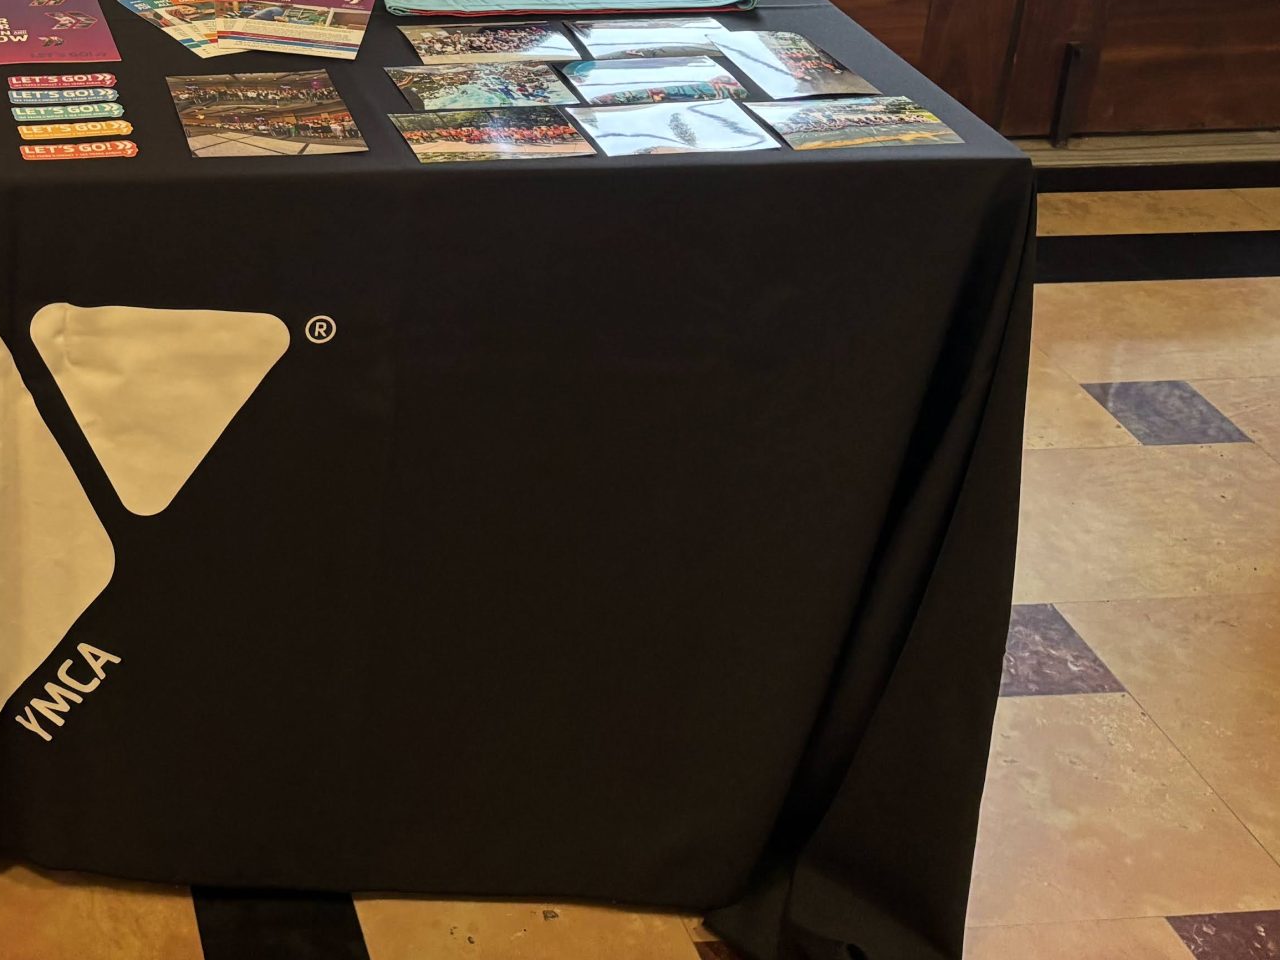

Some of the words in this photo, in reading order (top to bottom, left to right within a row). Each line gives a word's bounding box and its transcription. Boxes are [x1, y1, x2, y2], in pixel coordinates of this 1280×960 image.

[12, 75, 58, 84] LET'S
[12, 90, 60, 98] LET'S
[63, 89, 95, 98] GO!
[15, 107, 64, 115] LET'S
[67, 105, 99, 114] GO!
[23, 124, 72, 133] LET'S
[75, 122, 107, 131] GO!
[24, 145, 75, 154] LET'S
[79, 142, 112, 152] GO!
[16, 643, 121, 742] YMCA
